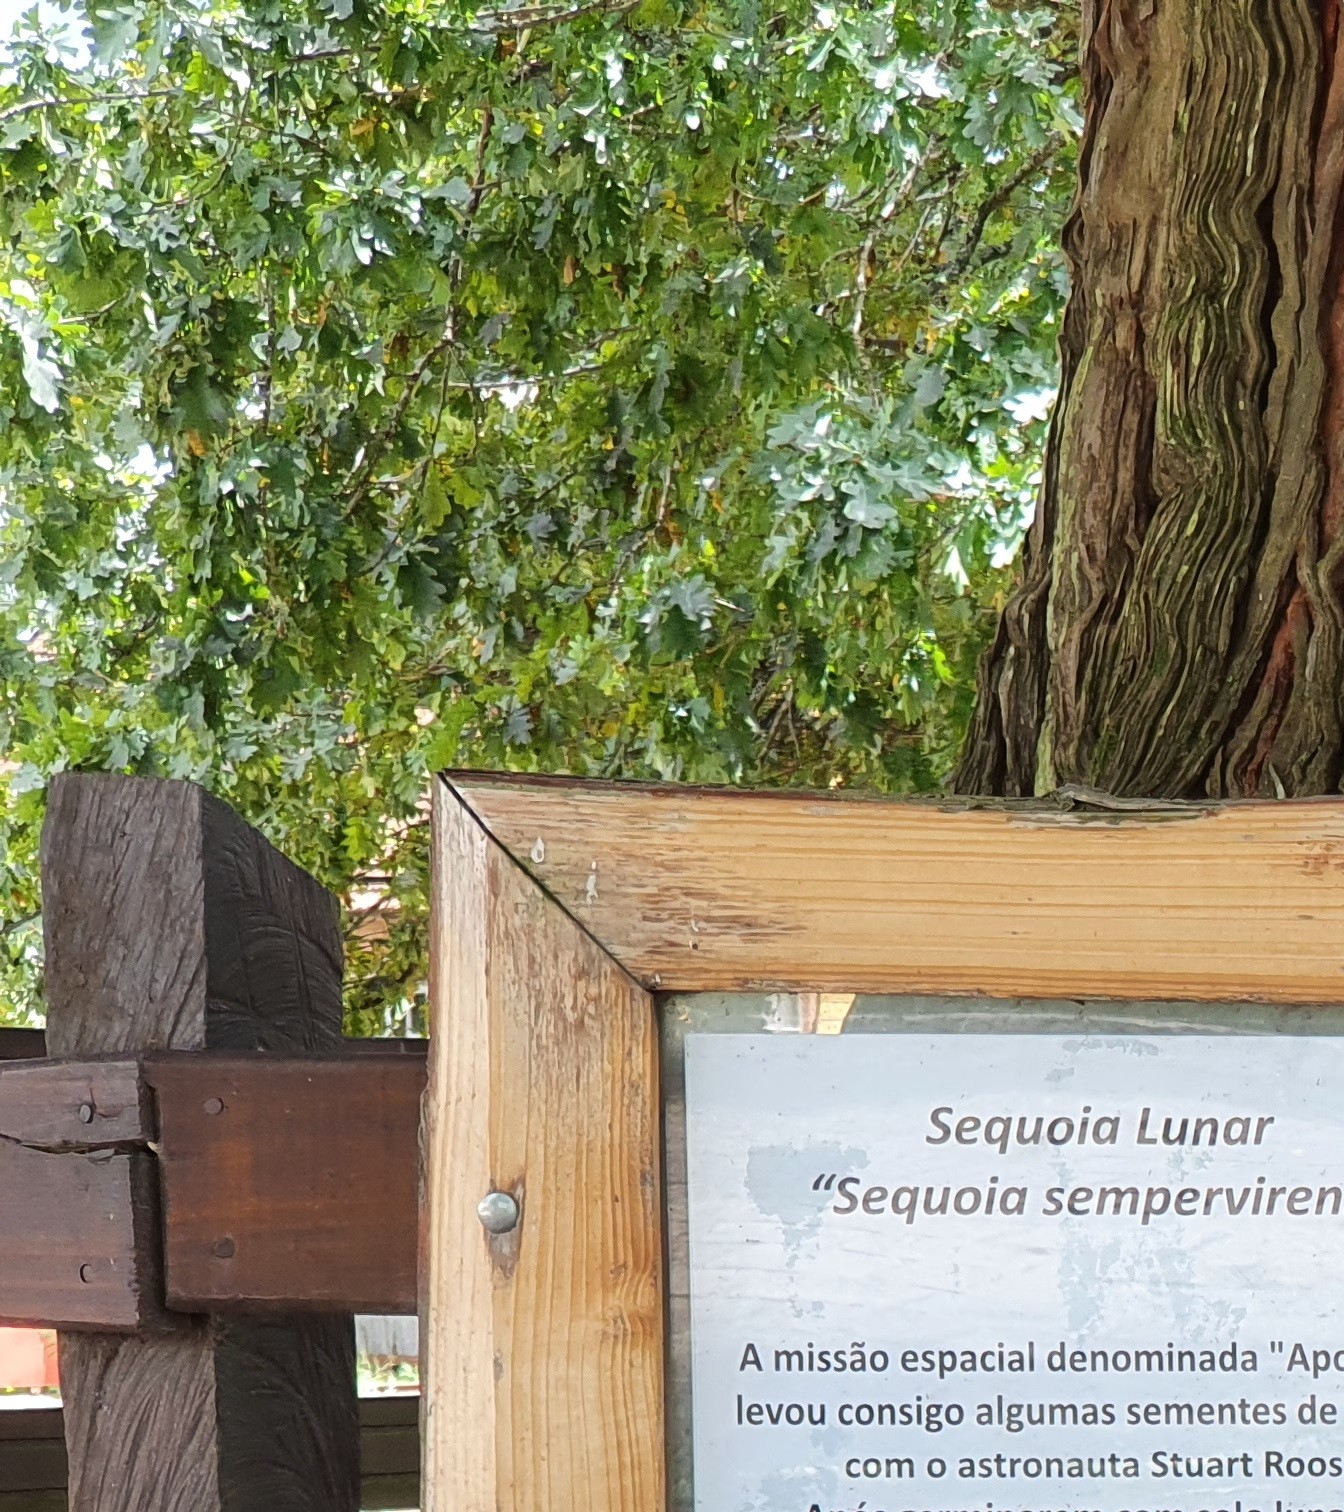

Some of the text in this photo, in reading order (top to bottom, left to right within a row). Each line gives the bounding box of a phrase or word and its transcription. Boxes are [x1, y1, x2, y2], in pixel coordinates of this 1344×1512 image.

[925, 1105, 1275, 1155] Sequoia Lunar
[812, 1173, 1028, 1225] “Sequoia
[739, 1342, 764, 1372] A
[774, 1341, 889, 1373] missão
[900, 1341, 1035, 1380] espacial
[1047, 1341, 1258, 1373] denominada
[736, 1394, 826, 1426] levou
[838, 1395, 965, 1433] consigo
[976, 1394, 1116, 1433] algumas
[1126, 1398, 1287, 1426] sementes
[1297, 1394, 1338, 1425] de
[845, 1457, 915, 1479] com
[926, 1457, 947, 1479] o
[958, 1453, 1140, 1479] astronauta
[1151, 1450, 1253, 1478] Stuart
